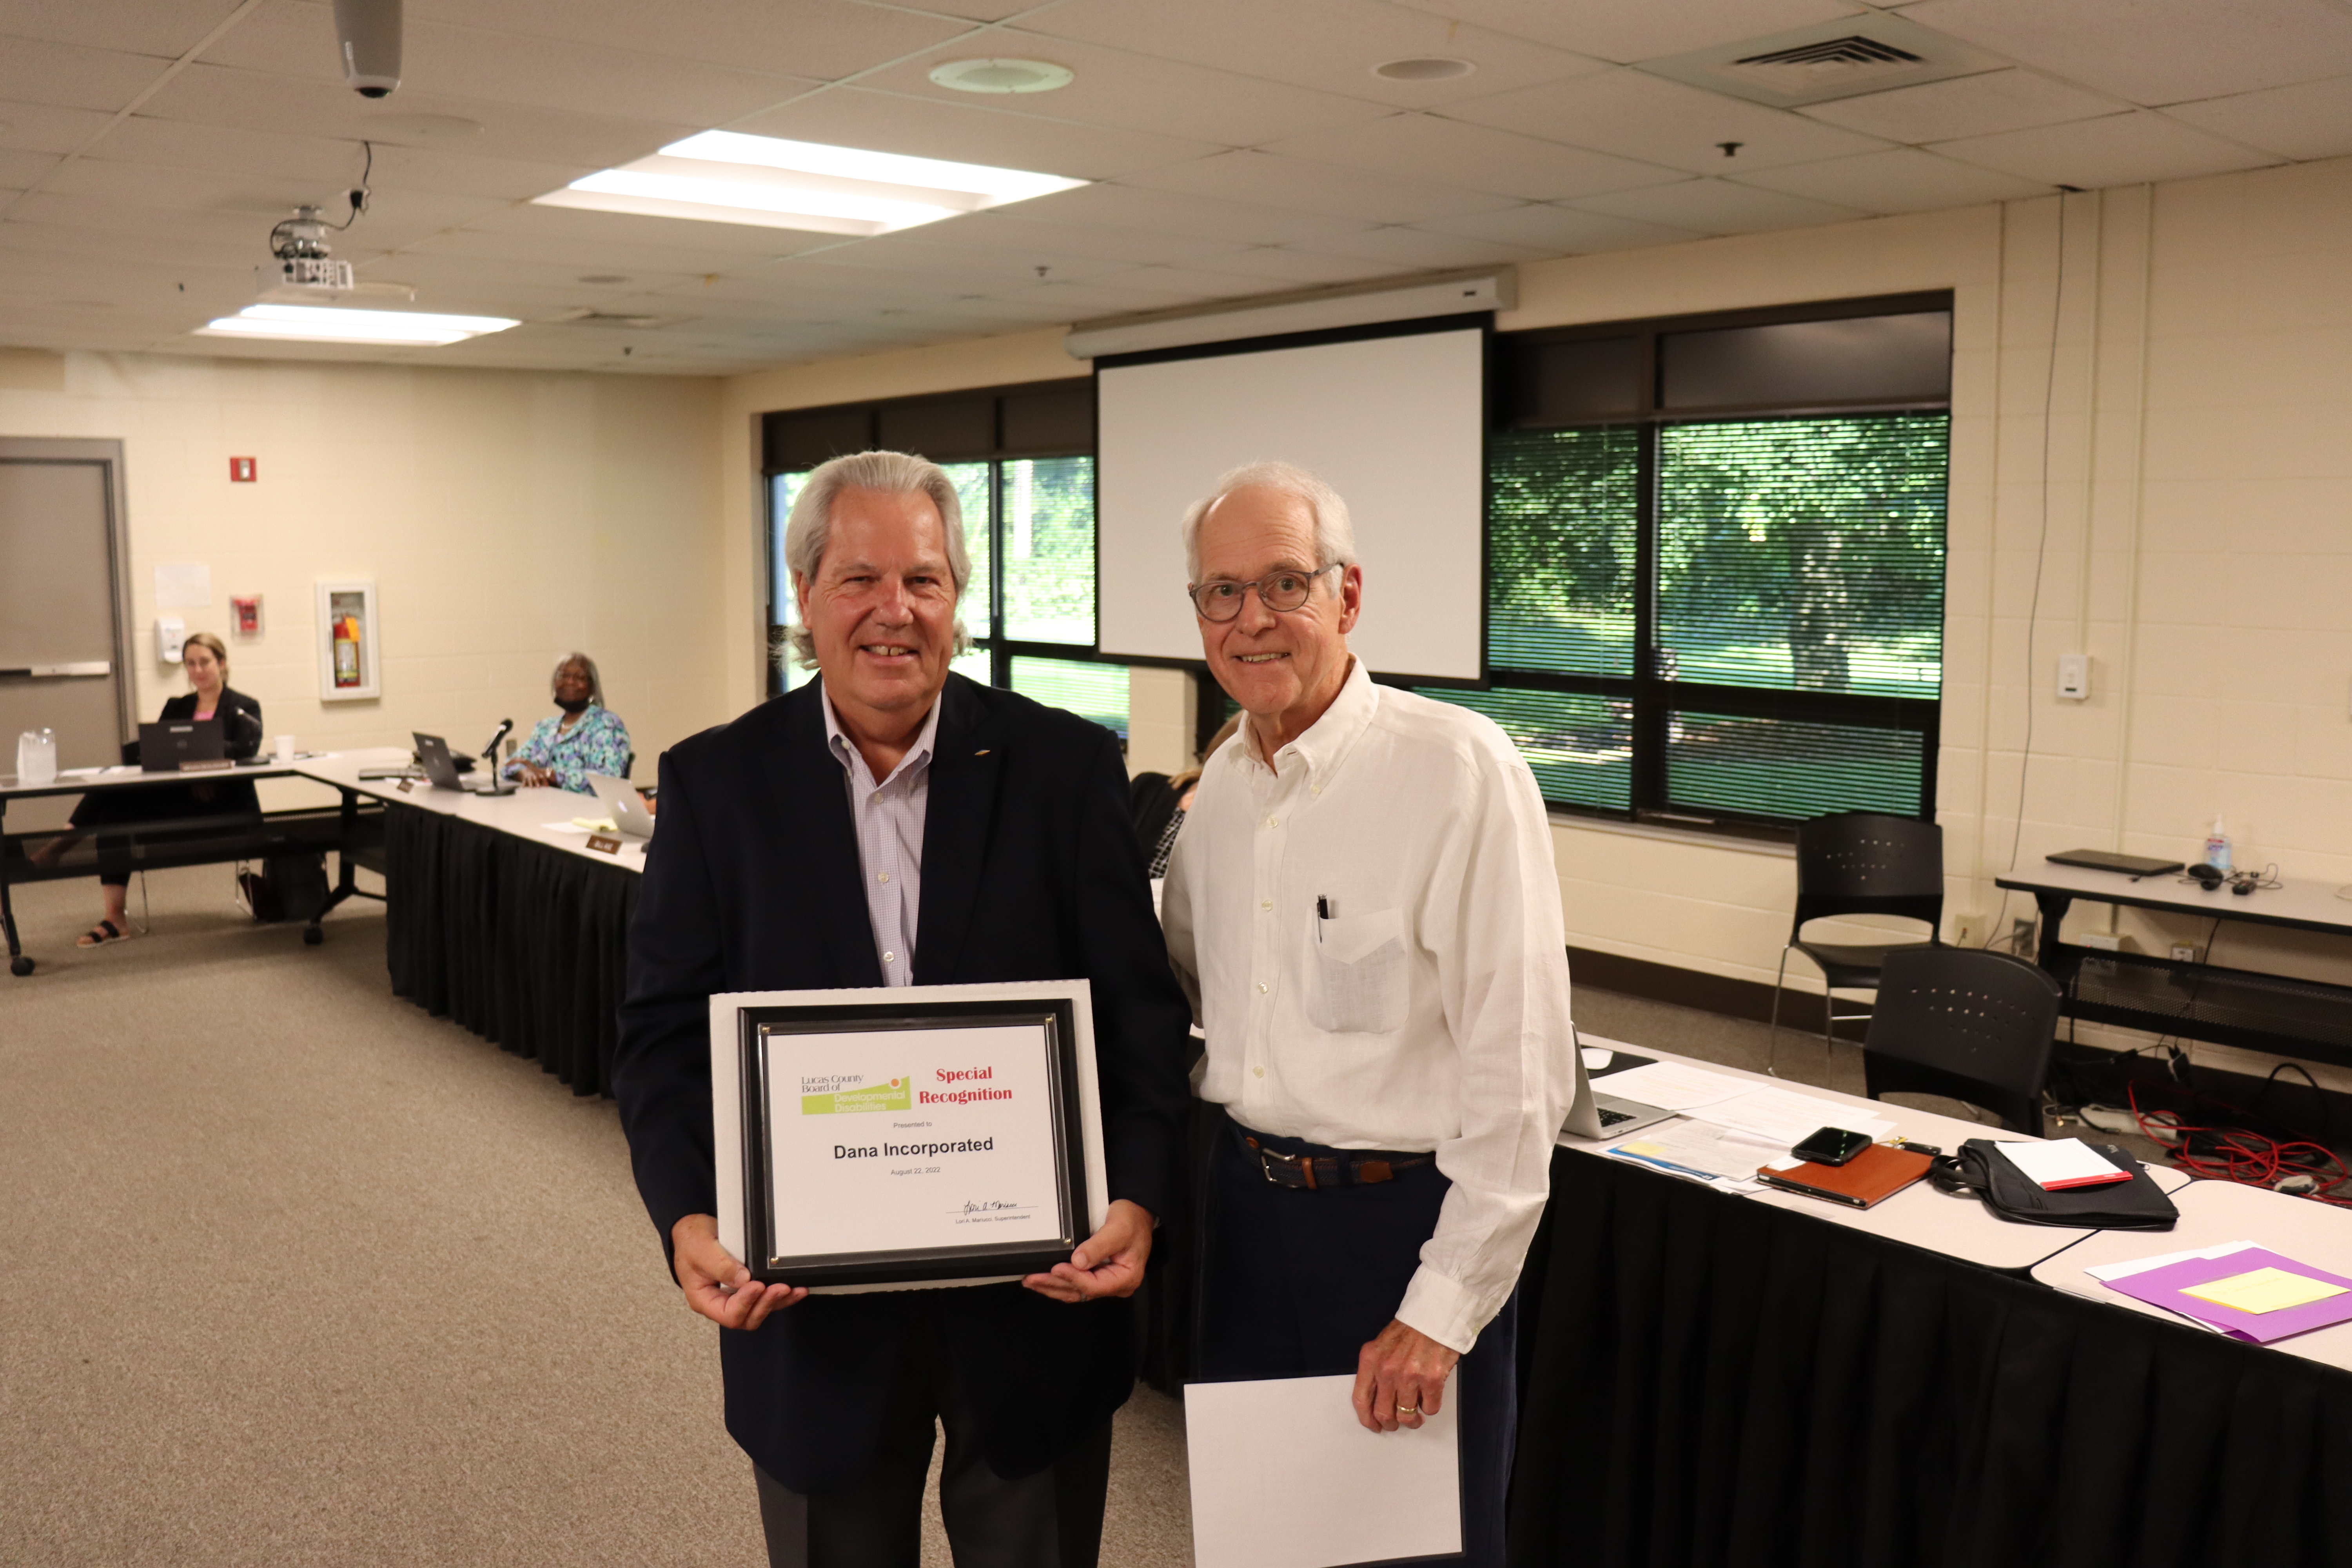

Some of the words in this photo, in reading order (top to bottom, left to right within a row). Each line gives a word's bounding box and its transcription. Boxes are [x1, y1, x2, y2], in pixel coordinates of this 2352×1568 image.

[801, 1076, 829, 1084] Lucas
[831, 1074, 864, 1083] County
[936, 1066, 992, 1084] Special
[802, 1083, 829, 1093] Board
[831, 1083, 840, 1091] of
[834, 1091, 906, 1102] Developmental
[919, 1087, 1013, 1105] Recognition
[835, 1102, 886, 1113] Disabilities
[834, 1145, 878, 1159] Dana
[884, 1136, 993, 1157] Incorporated
[891, 1167, 913, 1176] August
